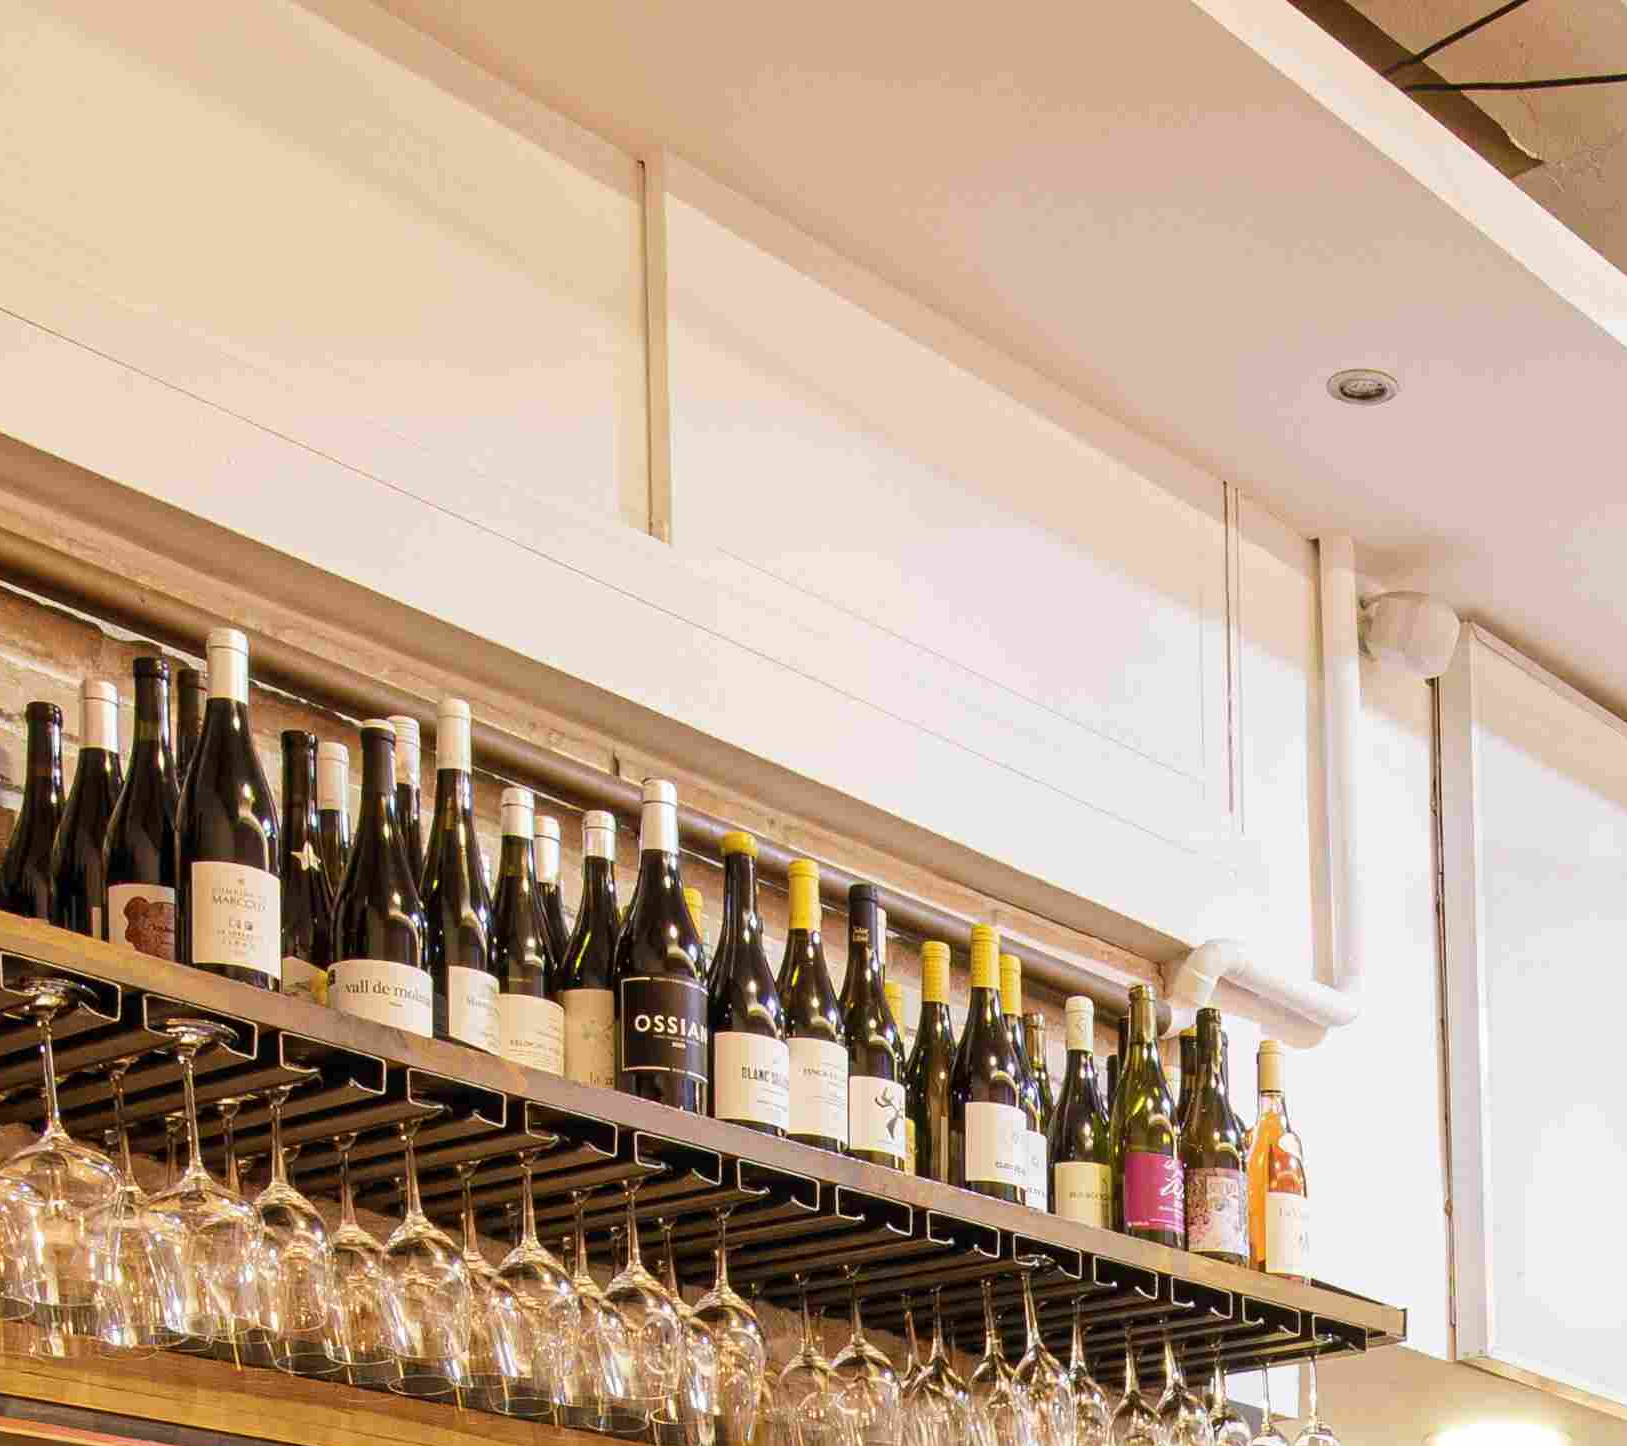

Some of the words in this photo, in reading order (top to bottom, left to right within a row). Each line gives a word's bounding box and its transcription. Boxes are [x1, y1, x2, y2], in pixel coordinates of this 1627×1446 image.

[344, 978, 369, 994] vall
[372, 979, 390, 994] de
[634, 1014, 708, 1044] OSSIAN
